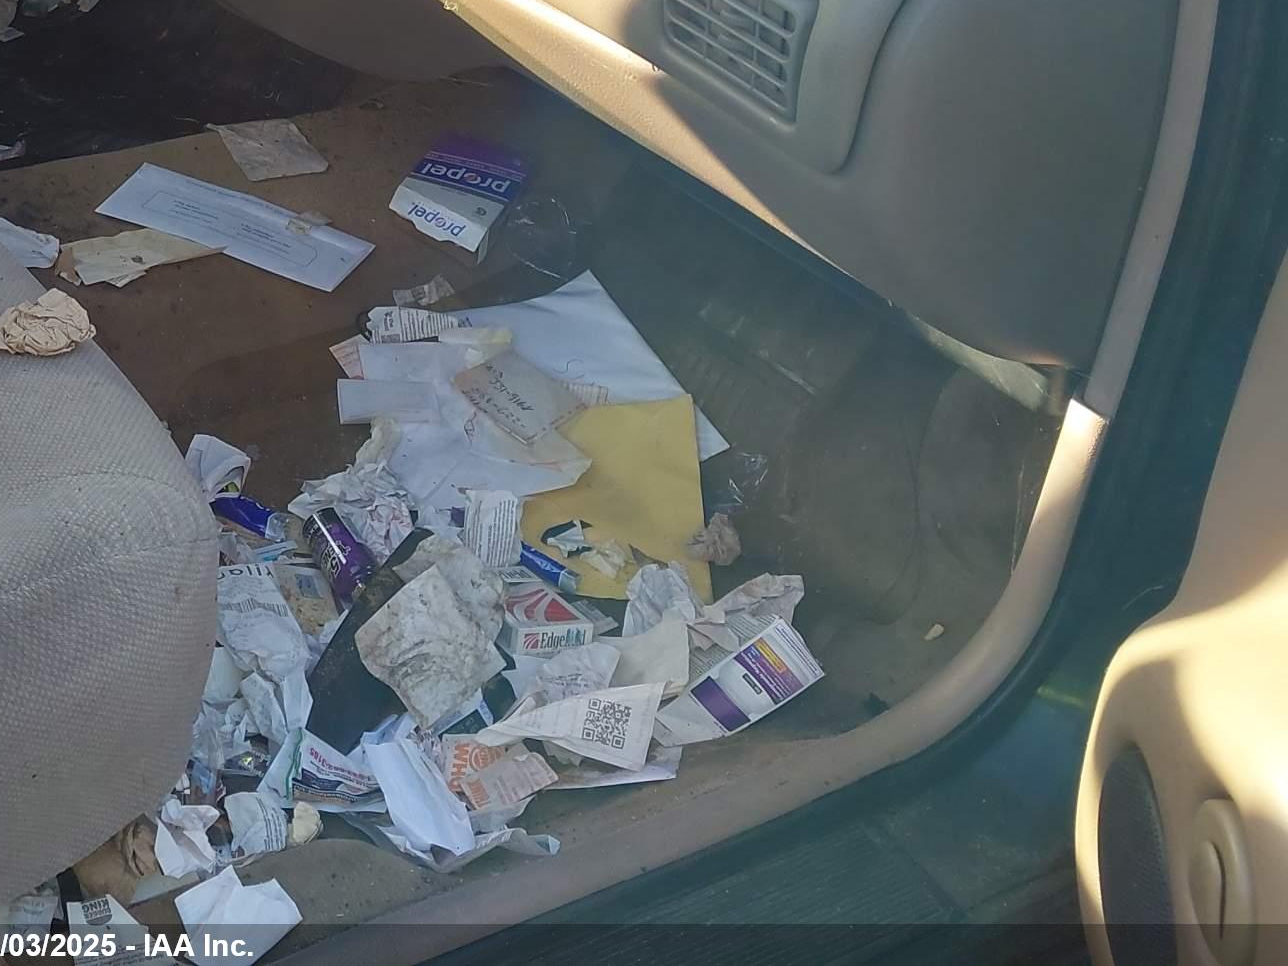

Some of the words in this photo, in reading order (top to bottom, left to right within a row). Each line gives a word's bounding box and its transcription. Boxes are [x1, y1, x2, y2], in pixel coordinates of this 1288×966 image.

[421, 163, 512, 194] propel
[408, 203, 467, 237] propel
[81, 898, 110, 914] KING
